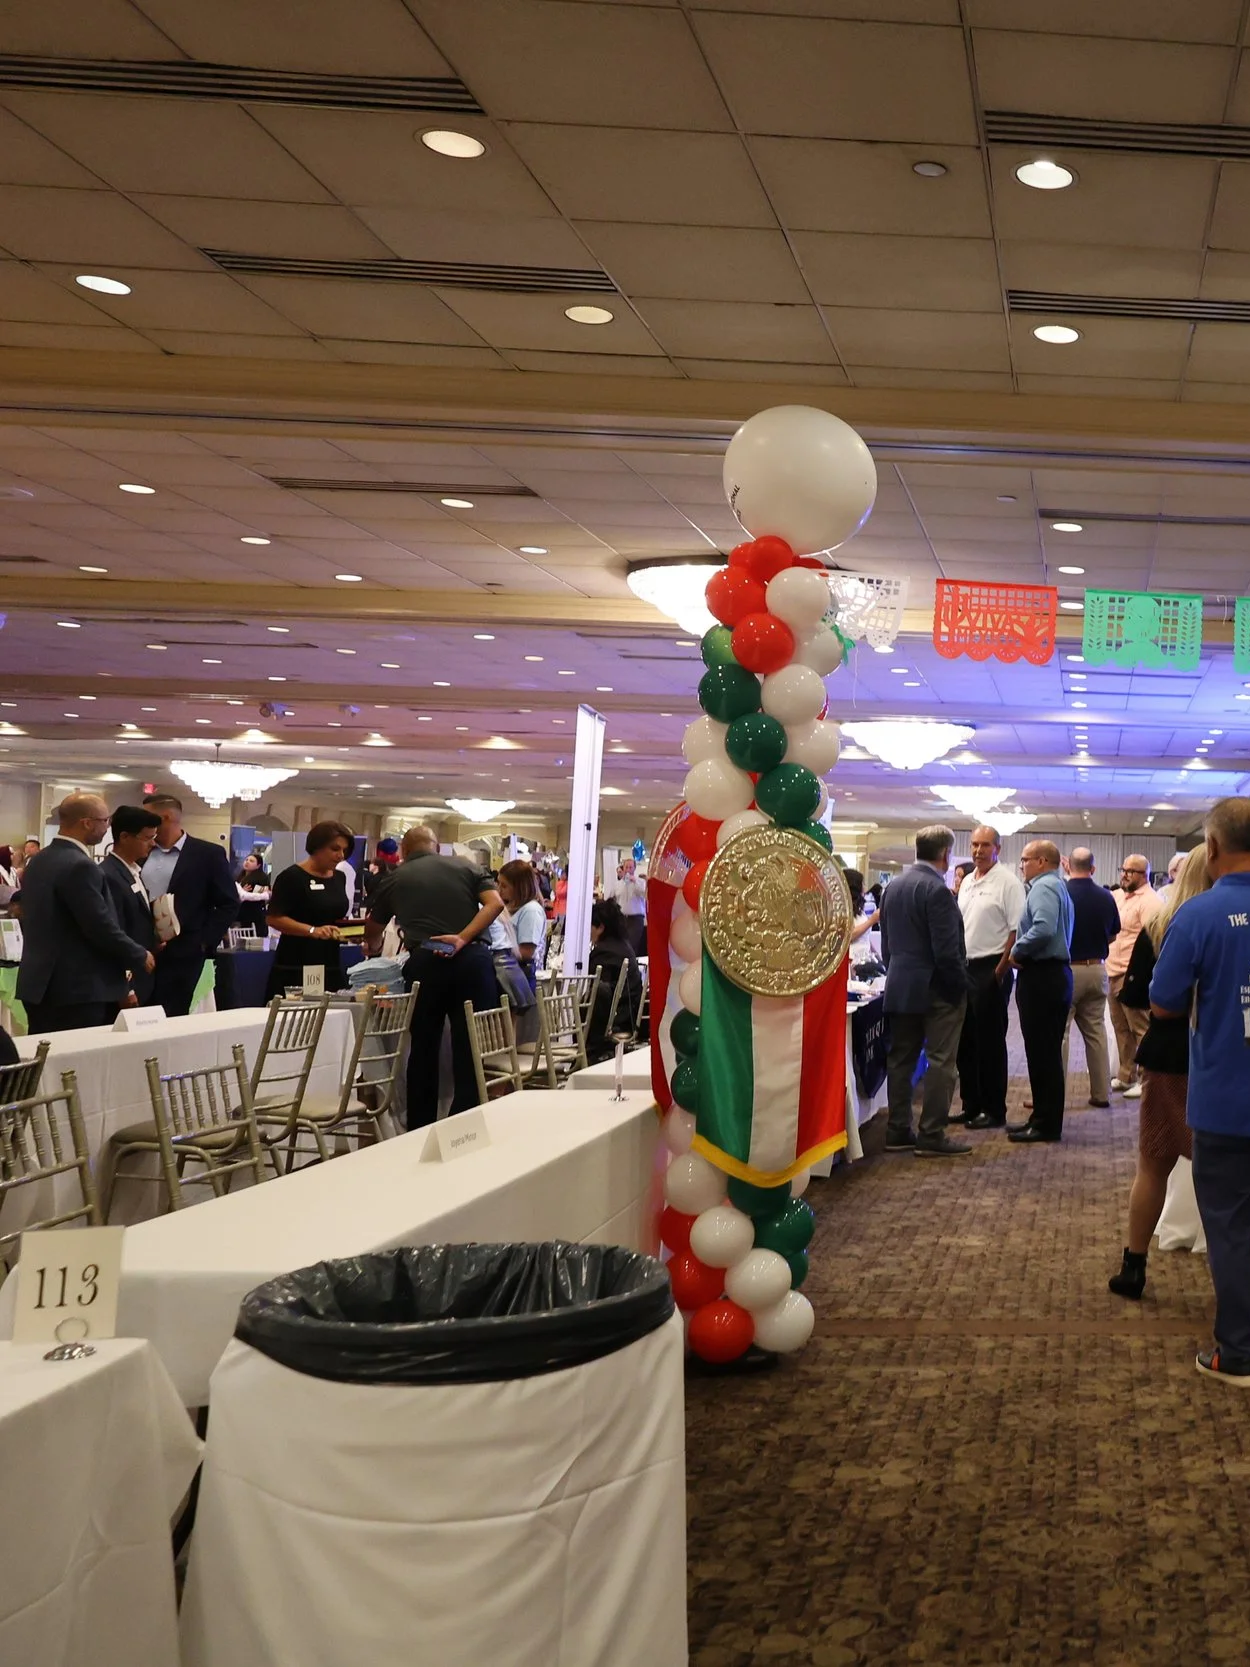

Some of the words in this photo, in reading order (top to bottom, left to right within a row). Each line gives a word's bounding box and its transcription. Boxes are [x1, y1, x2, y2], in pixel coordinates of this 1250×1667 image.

[1228, 912, 1248, 927] THE
[307, 974, 321, 986] 108
[33, 1263, 100, 1309] 113
